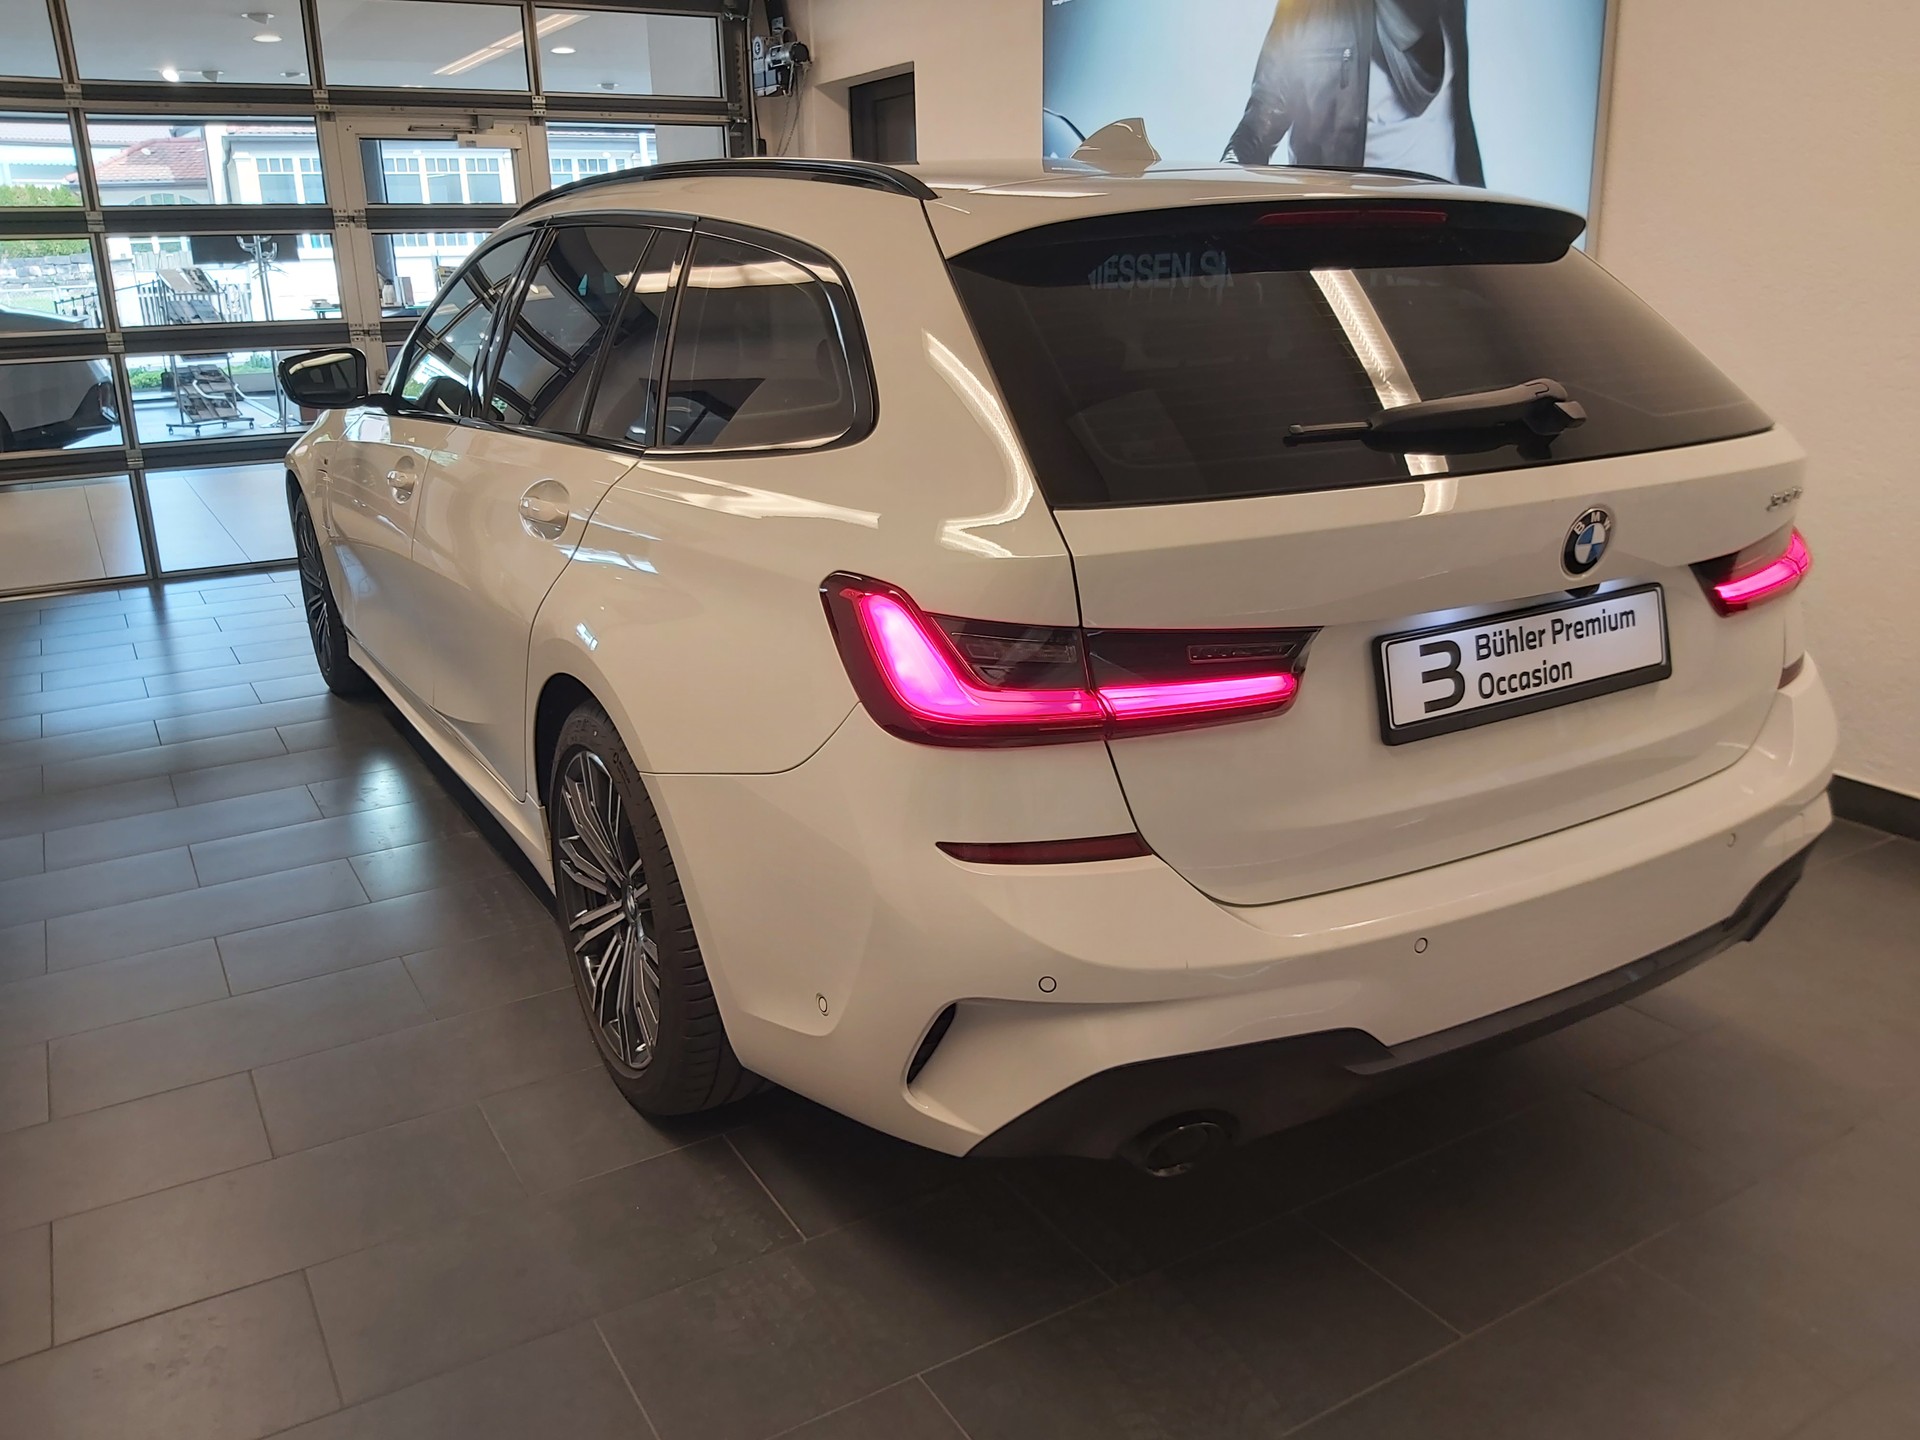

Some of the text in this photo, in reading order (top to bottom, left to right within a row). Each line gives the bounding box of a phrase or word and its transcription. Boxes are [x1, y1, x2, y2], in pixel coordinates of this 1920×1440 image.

[1573, 511, 1611, 536] BMW
[1475, 608, 1636, 661] Bühler Premium
[1478, 660, 1573, 700] Occasion
